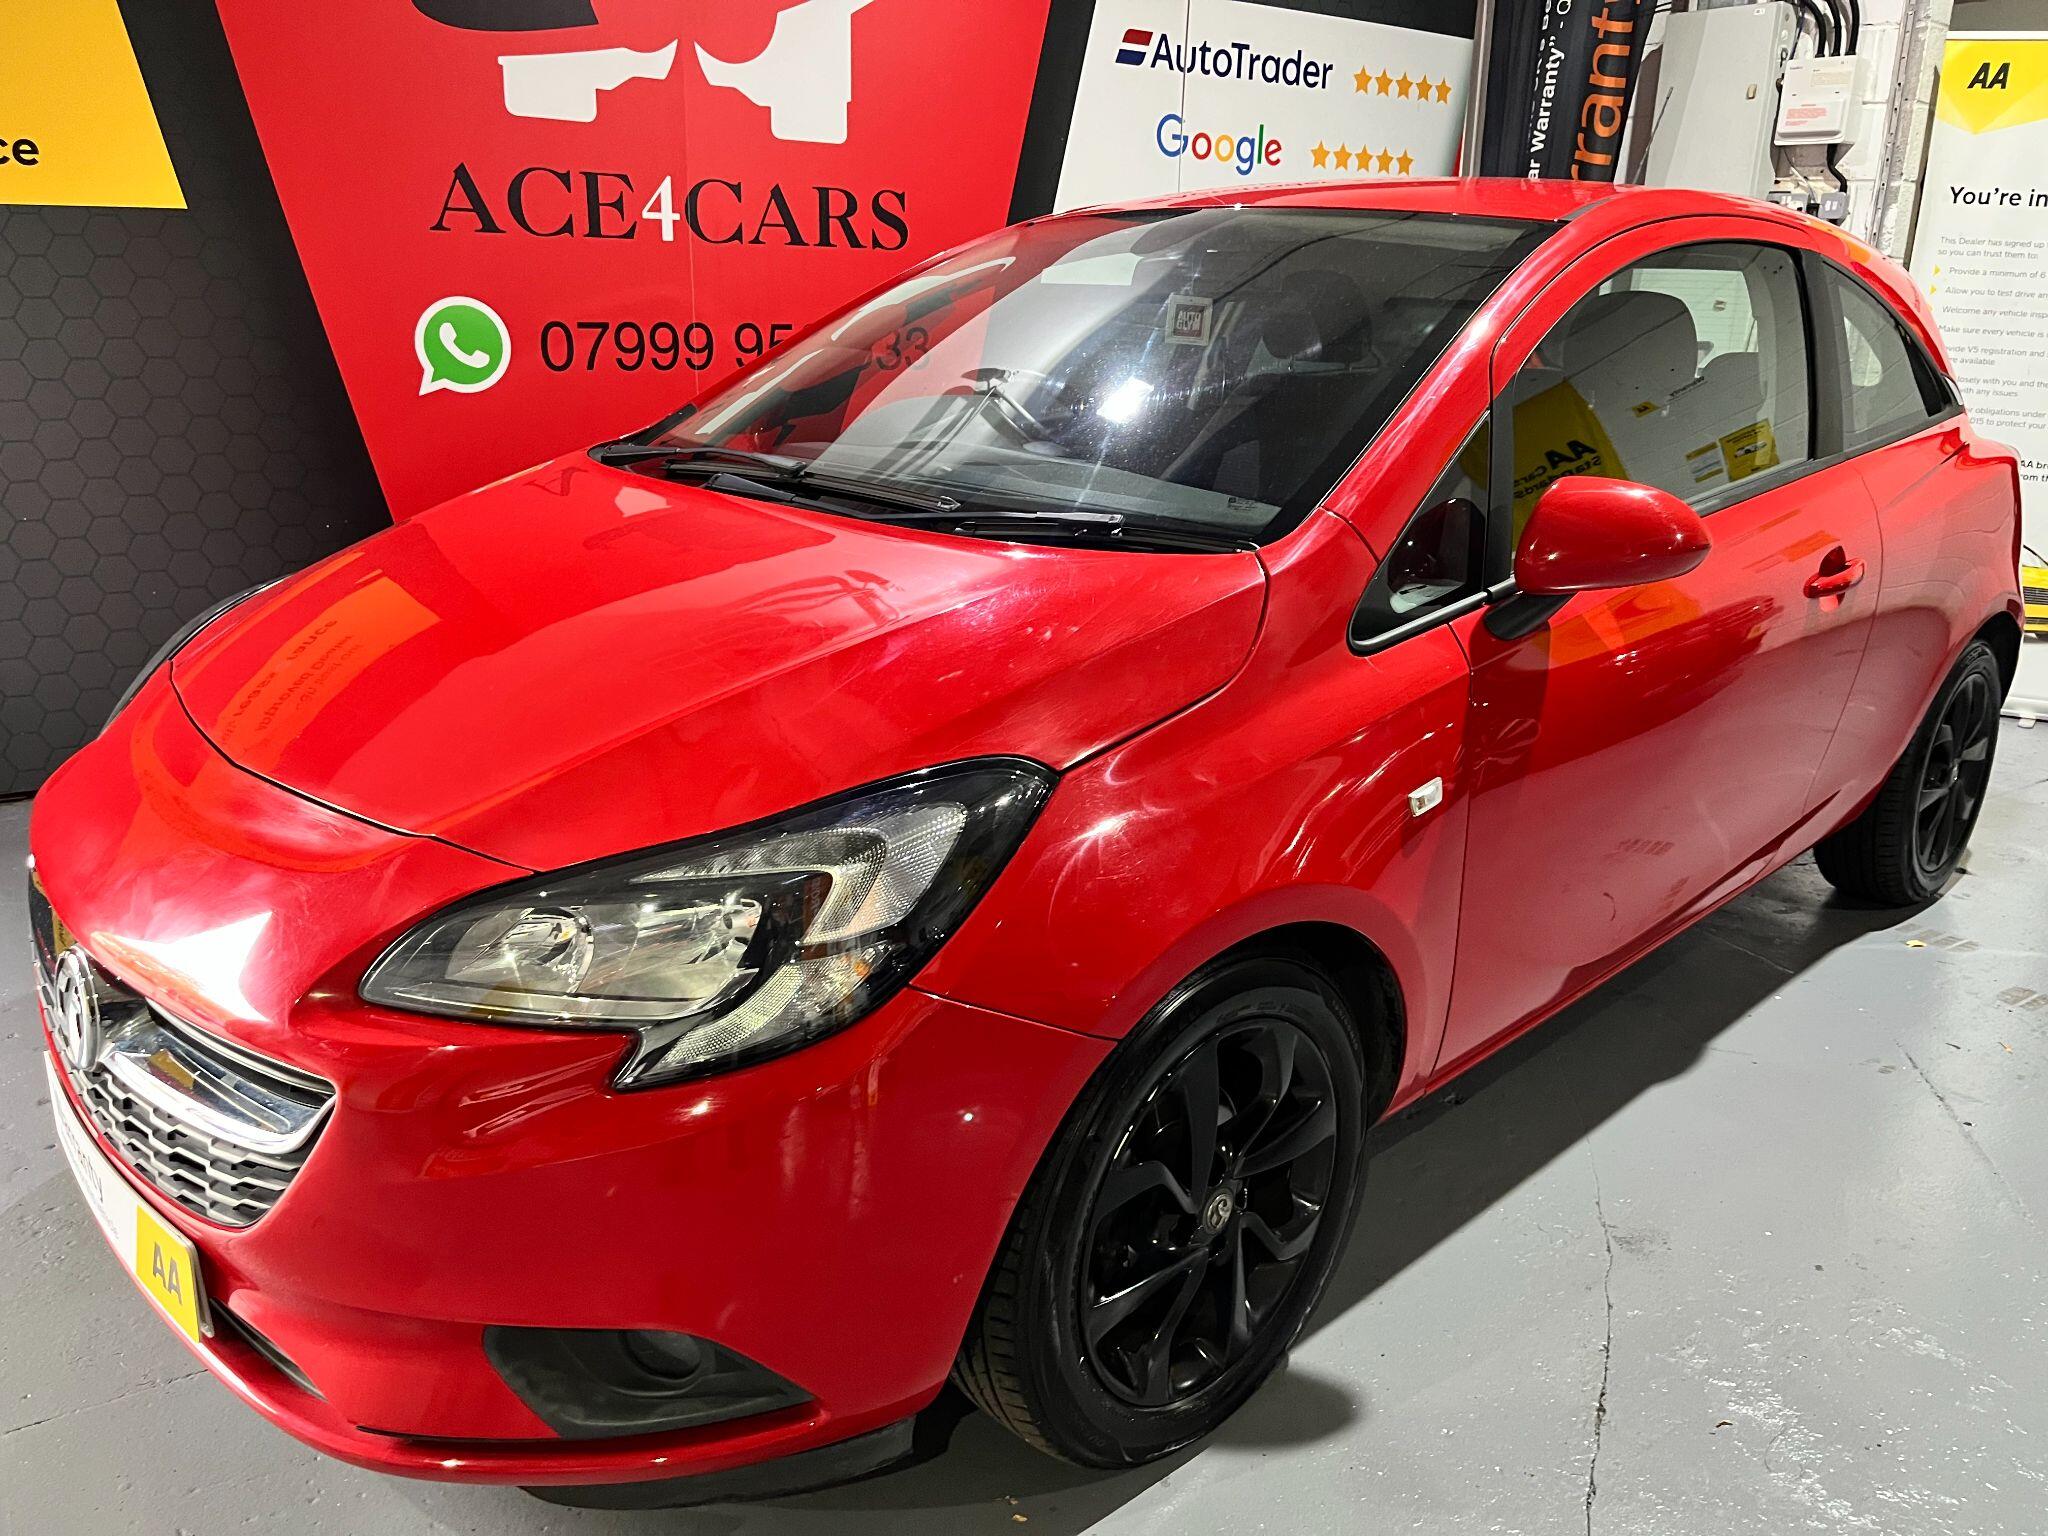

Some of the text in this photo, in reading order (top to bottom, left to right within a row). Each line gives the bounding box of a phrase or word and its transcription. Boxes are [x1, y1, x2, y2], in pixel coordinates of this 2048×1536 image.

[1150, 33, 1333, 89] AutoTrader
[1967, 62, 2010, 89] AA
[1571, 0, 1640, 181] rant
[1156, 113, 1282, 176] Google
[1950, 186, 2022, 206] You’re
[430, 162, 909, 251] ACE4CARS
[1941, 236, 1957, 245] This
[1959, 237, 1986, 246] Dealer
[1988, 239, 2003, 247] has
[2005, 240, 2032, 248] signed
[1983, 250, 2003, 258] trust
[2005, 251, 2025, 259] them
[1949, 266, 1981, 276] Provide
[1989, 269, 2028, 278] minimum
[2030, 270, 2039, 279] of
[1945, 286, 1969, 294] Allow
[1970, 288, 1986, 297] you
[1988, 288, 1997, 296] to
[1997, 289, 2013, 297] test
[2015, 290, 2037, 298] drive
[1942, 305, 1981, 315] Welcome
[1983, 309, 1998, 318] any
[1999, 309, 2028, 317] vehicle
[1963, 327, 1981, 335] sure
[1982, 328, 2005, 337] every
[2006, 329, 2035, 338] vehicle
[540, 320, 715, 372] 07999
[1980, 347, 2028, 357] registration
[2029, 349, 2045, 358] and
[1959, 358, 1996, 366] available
[1982, 377, 2001, 385] with
[2002, 379, 2017, 387] you
[2019, 379, 2035, 387] and
[1976, 388, 1991, 396] any
[1975, 407, 2020, 417] obligations
[2022, 409, 2047, 418] under
[1996, 419, 2027, 429] protect
[2028, 421, 2046, 430] your
[153, 1241, 182, 1306] AA
